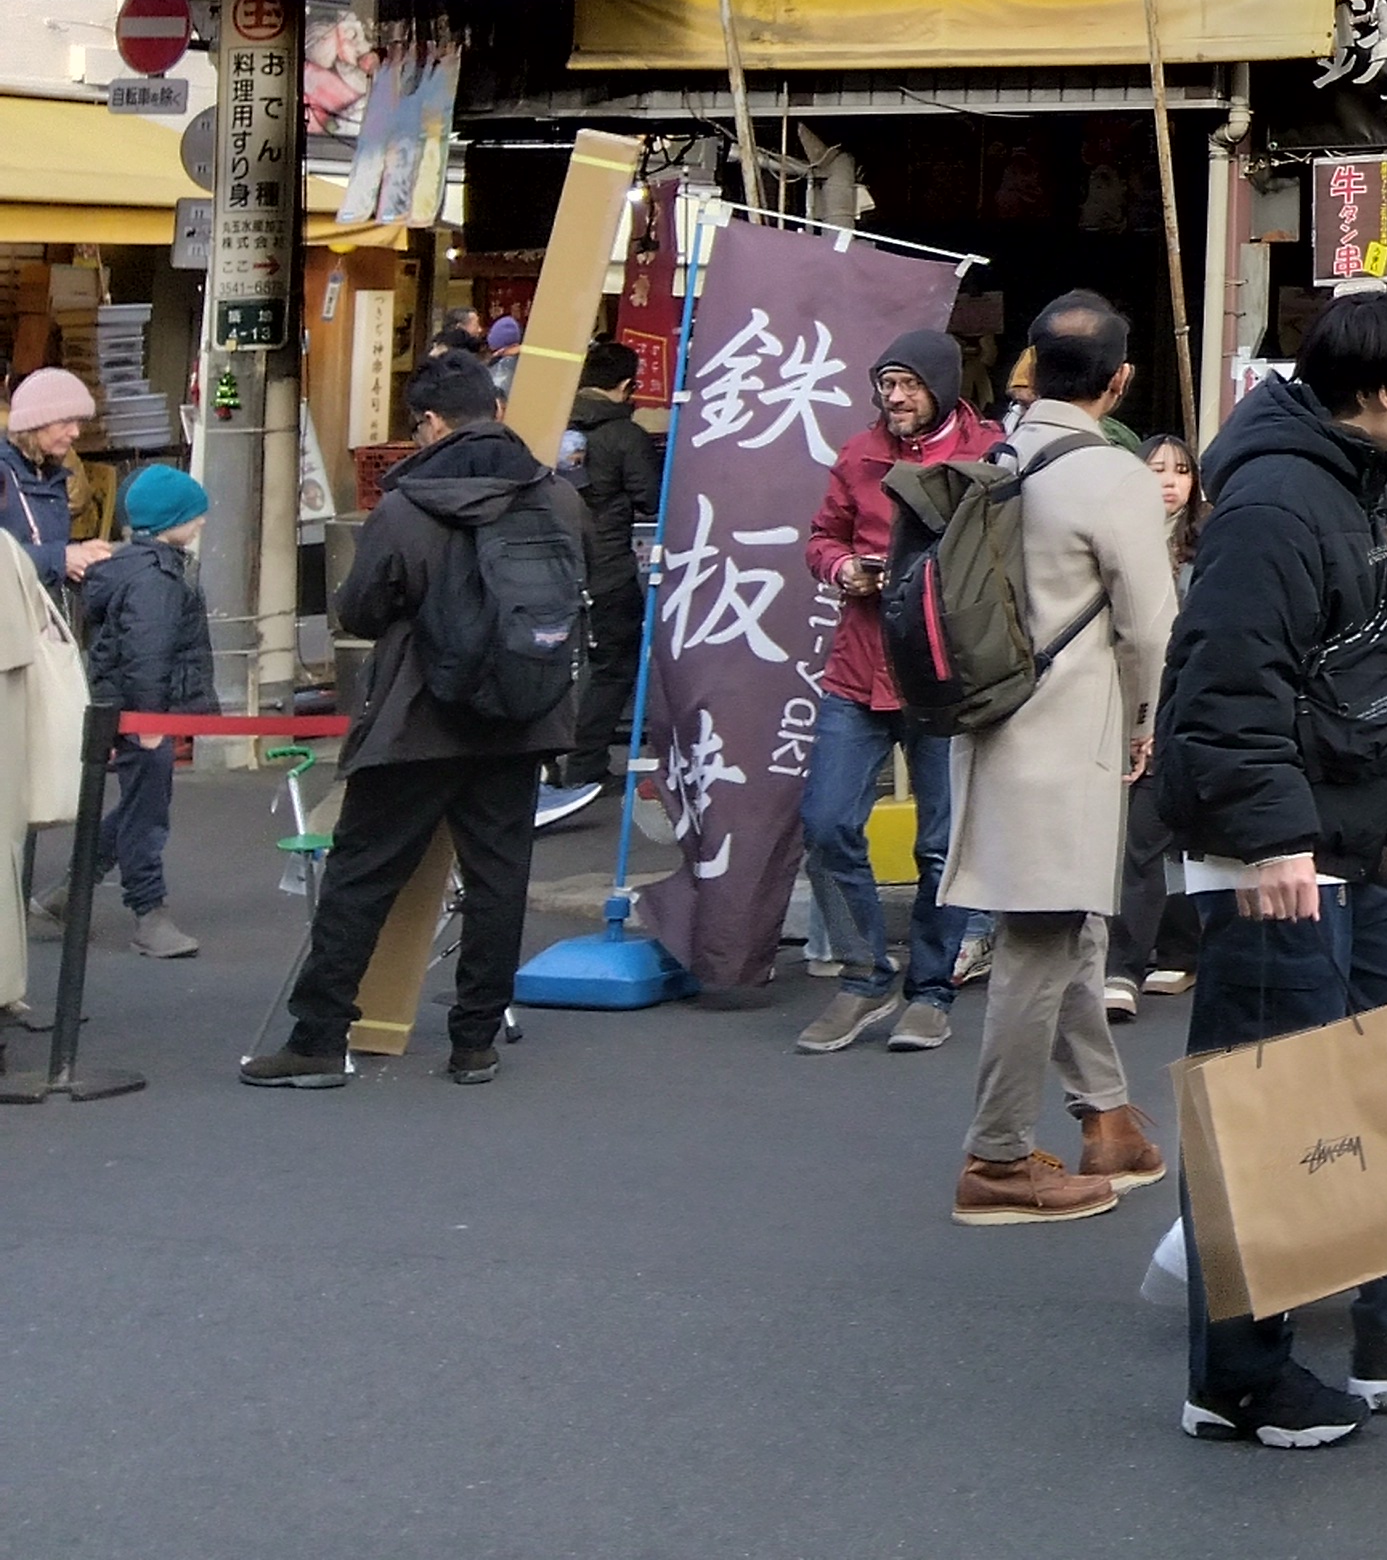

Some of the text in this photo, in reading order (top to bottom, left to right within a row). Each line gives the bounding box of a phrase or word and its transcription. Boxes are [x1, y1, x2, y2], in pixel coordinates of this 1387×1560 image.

[112, 88, 182, 108] 自転車を除く
[229, 52, 254, 208] 料理用すり身
[255, 52, 286, 208] おでん種
[222, 260, 249, 274] ここ
[1330, 165, 1367, 277] 牛タン串
